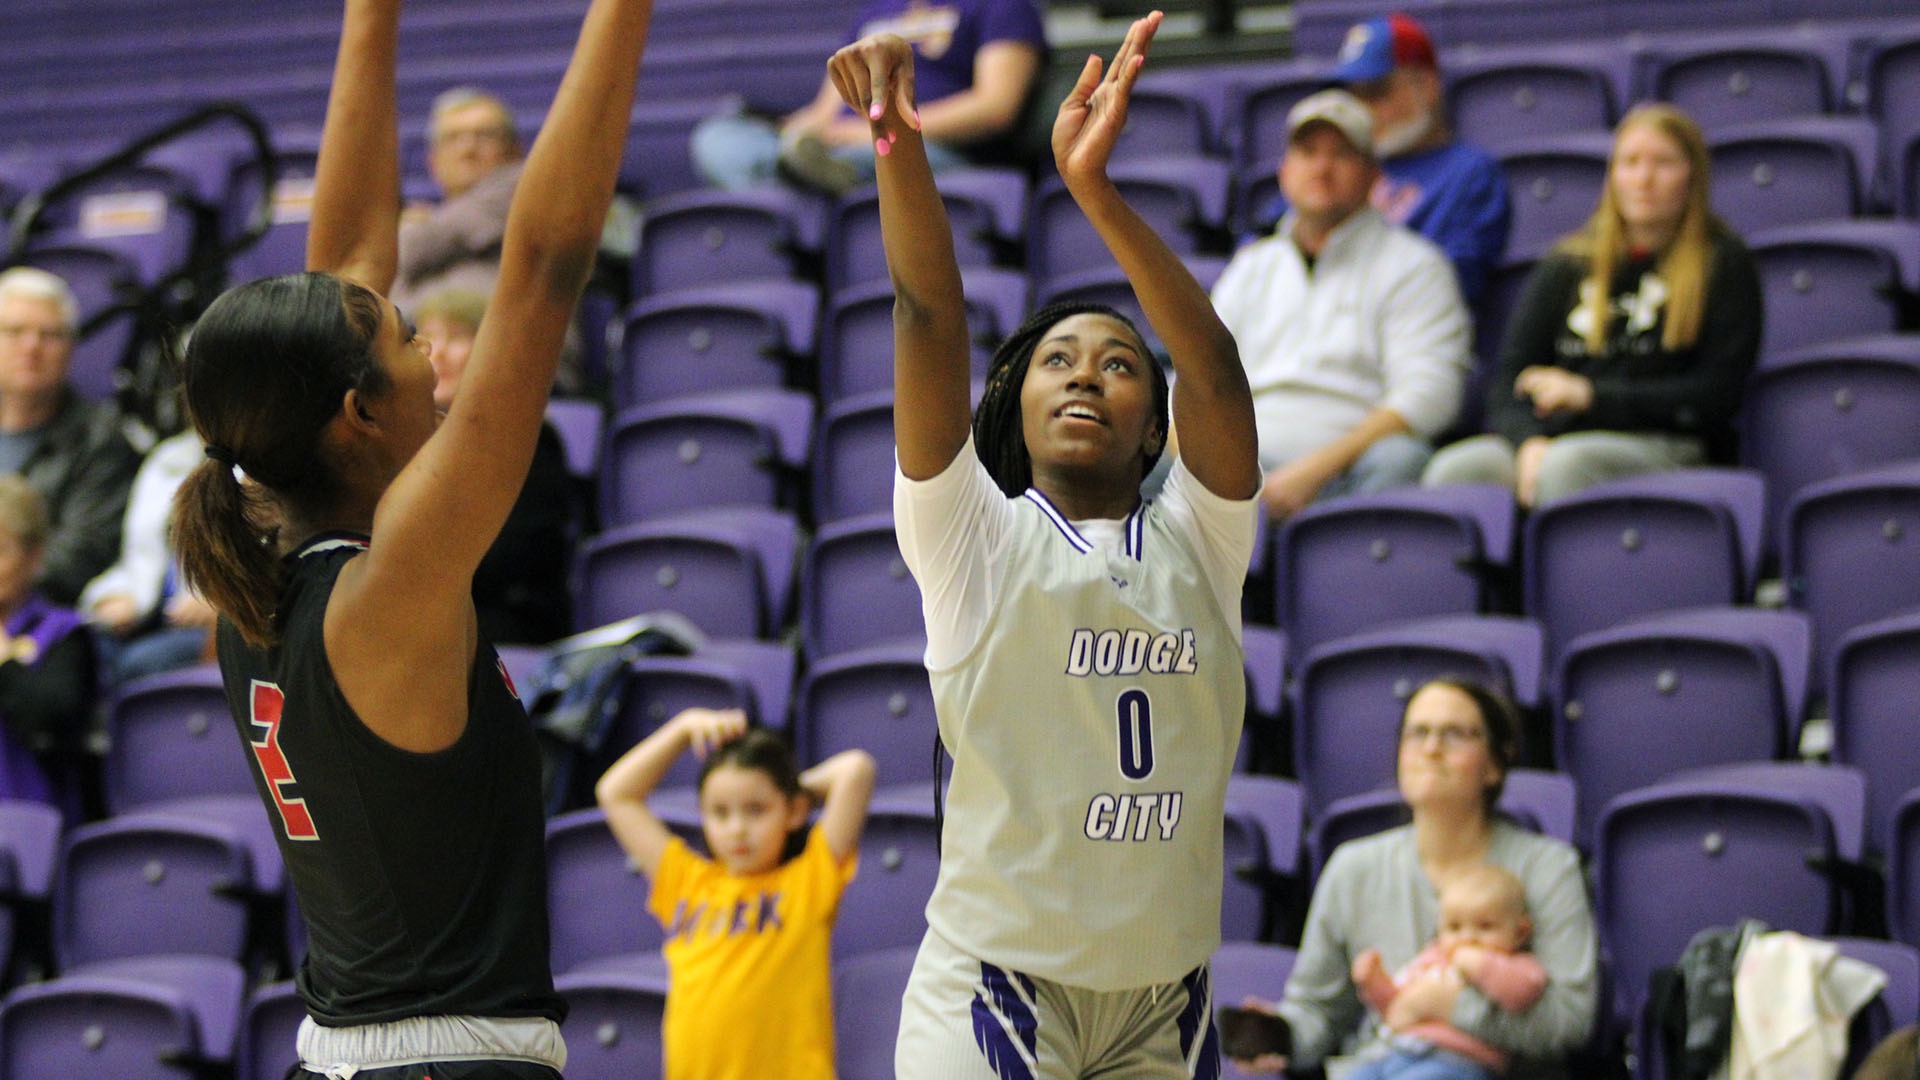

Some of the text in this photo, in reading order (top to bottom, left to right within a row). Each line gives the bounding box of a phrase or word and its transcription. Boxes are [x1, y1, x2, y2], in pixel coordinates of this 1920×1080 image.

[1065, 628, 1198, 677] DODGE
[250, 679, 320, 841] 2
[1115, 686, 1156, 782] 0
[1084, 792, 1183, 842] CITY
